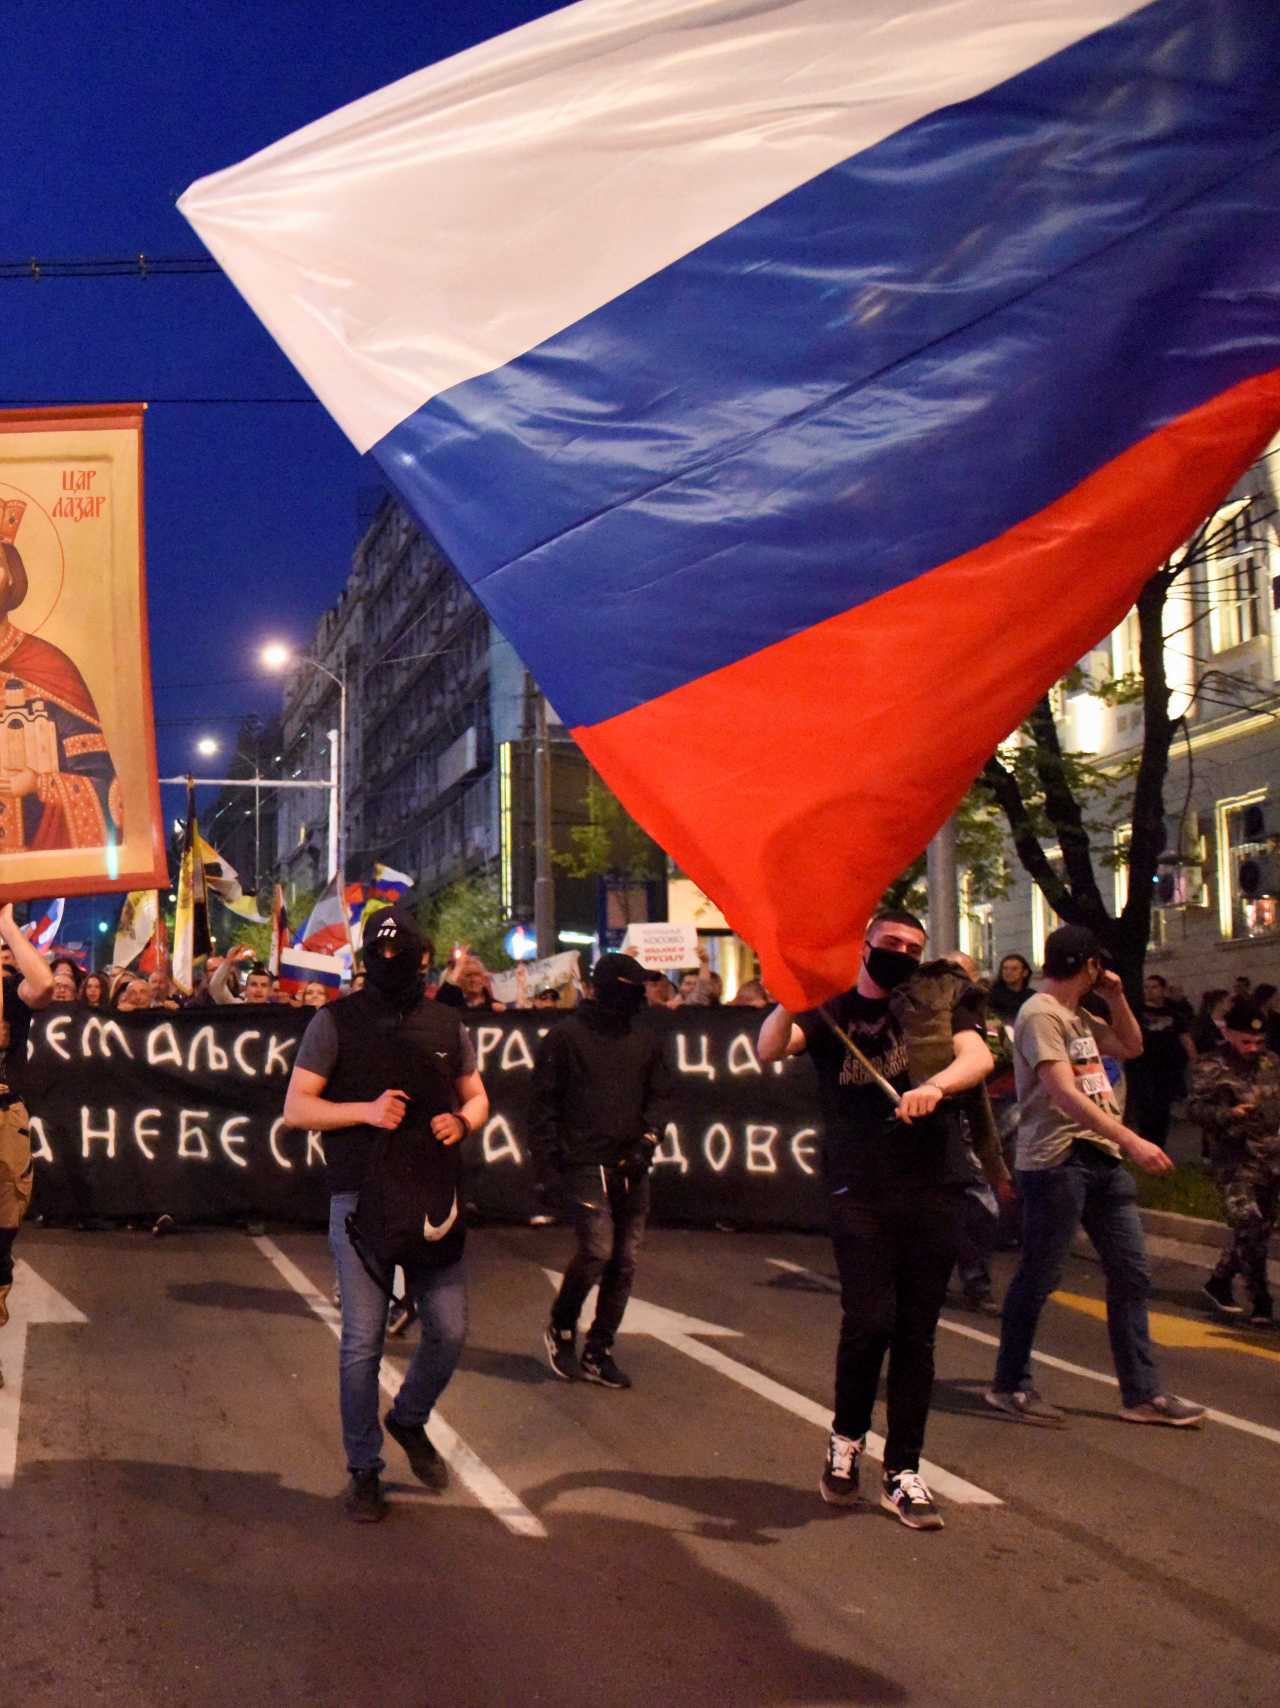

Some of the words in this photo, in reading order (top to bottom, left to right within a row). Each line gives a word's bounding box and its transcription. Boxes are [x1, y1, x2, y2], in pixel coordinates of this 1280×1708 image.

[61, 470, 96, 495] ЦАР
[51, 495, 106, 523] ЛАЗАР
[27, 1014, 297, 1076] ЕМАЉСК
[79, 1104, 327, 1169] НЕБЕСК
[648, 1121, 819, 1176] ДОВЕ
